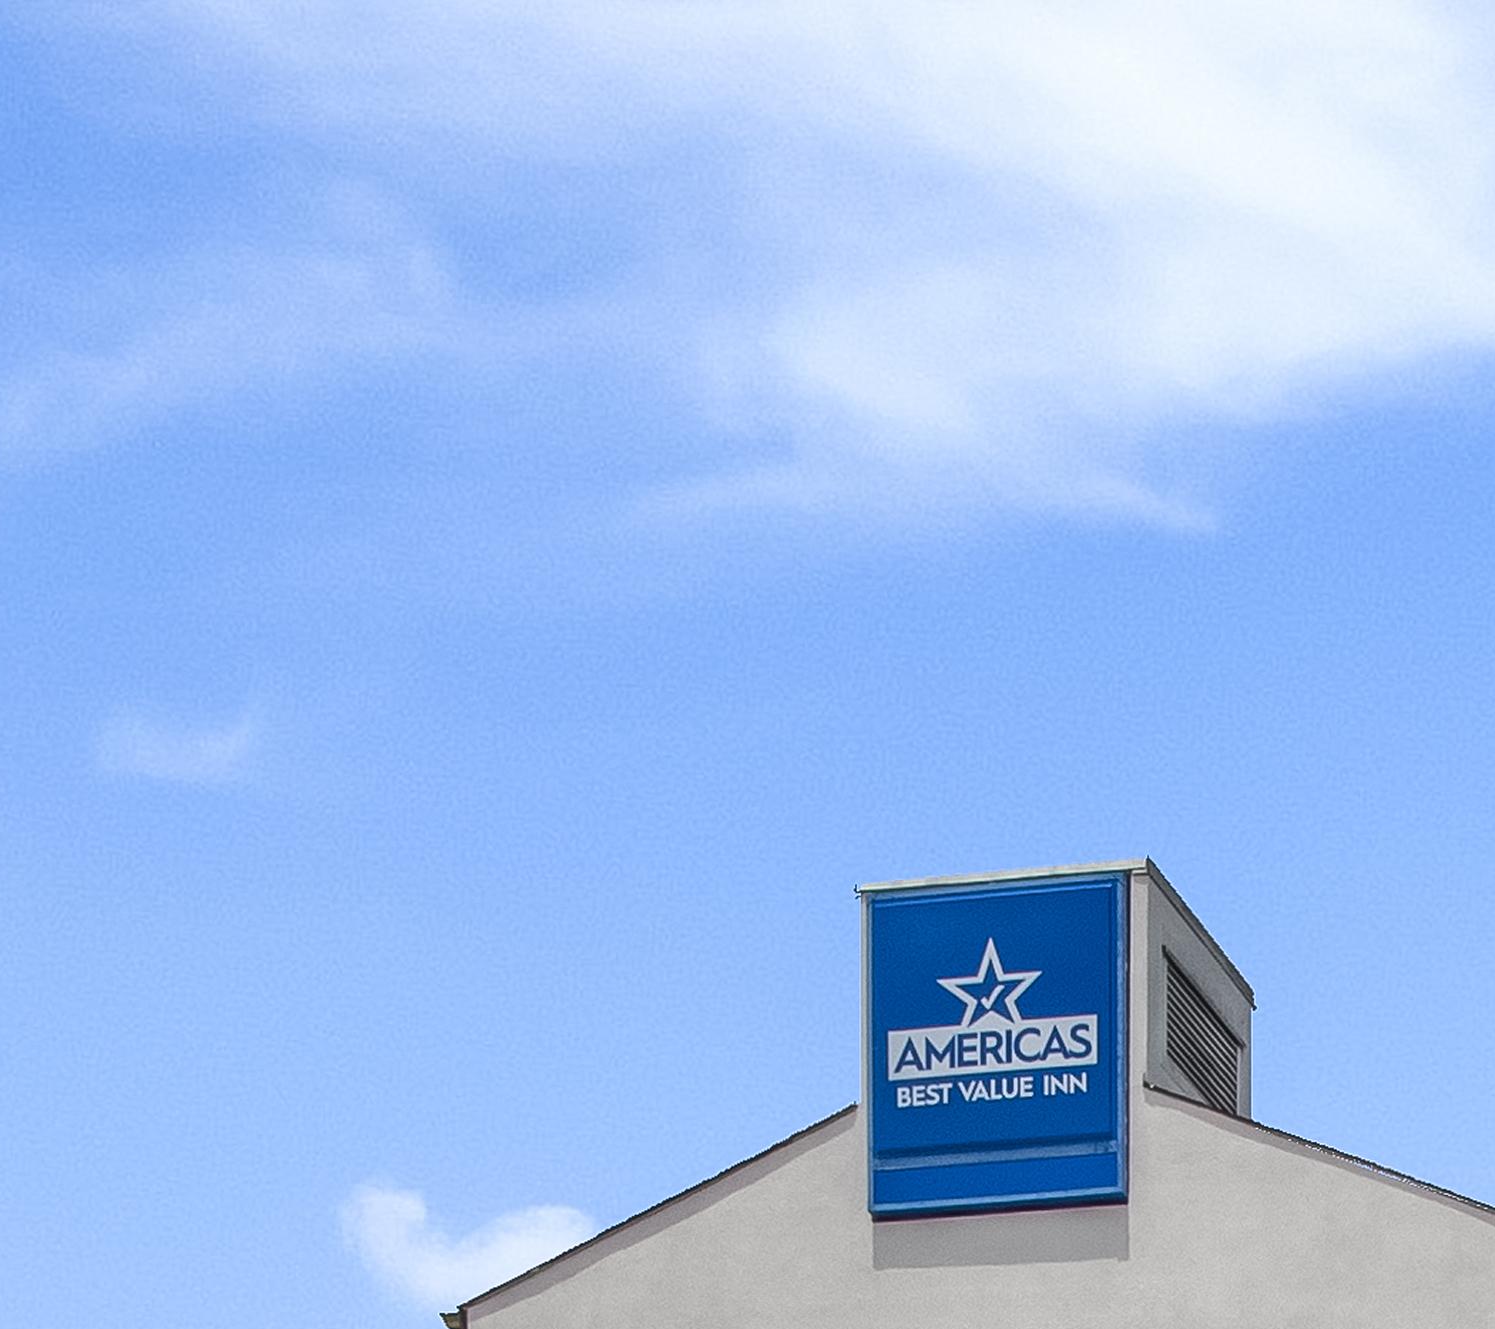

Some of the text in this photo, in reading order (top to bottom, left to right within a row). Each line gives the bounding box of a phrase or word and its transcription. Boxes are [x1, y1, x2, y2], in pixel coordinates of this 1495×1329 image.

[894, 1023, 1093, 1074] AMERICAS
[897, 1072, 1088, 1109] BEST VALUE INN
